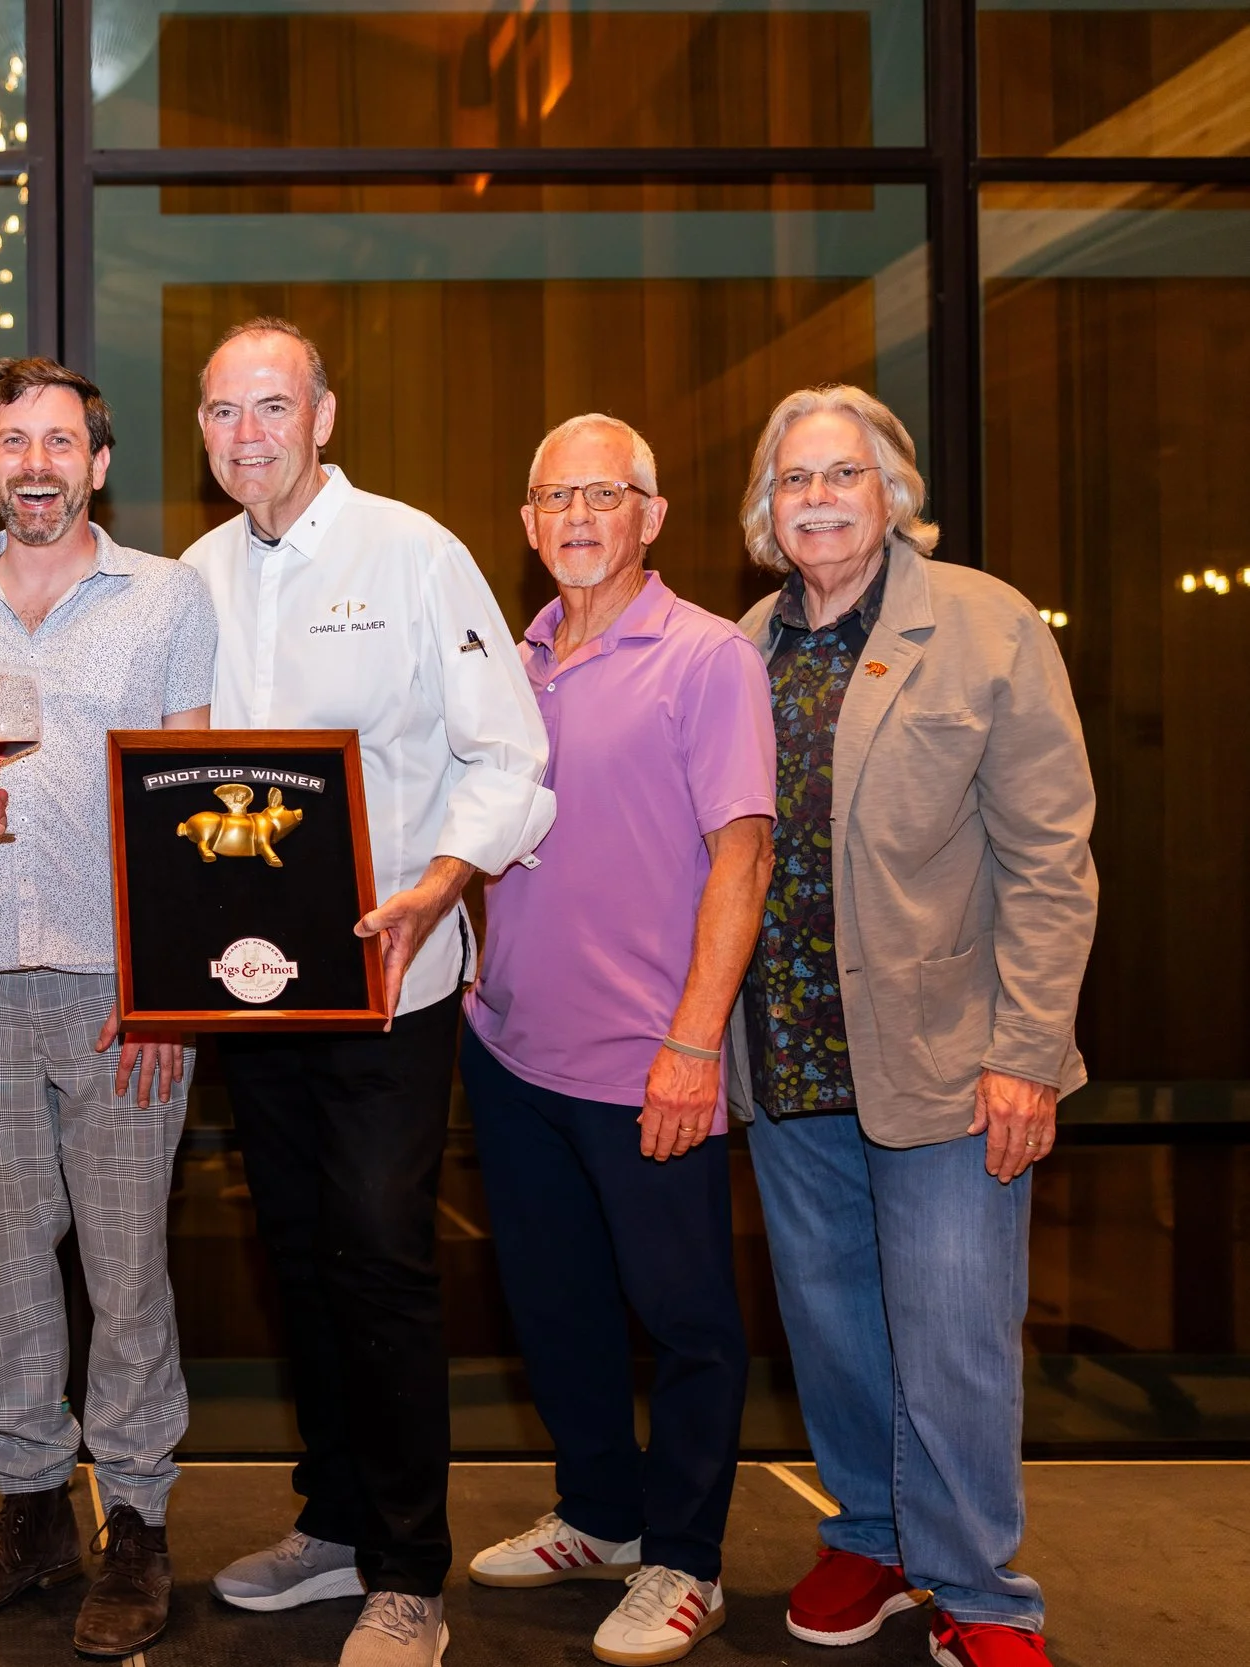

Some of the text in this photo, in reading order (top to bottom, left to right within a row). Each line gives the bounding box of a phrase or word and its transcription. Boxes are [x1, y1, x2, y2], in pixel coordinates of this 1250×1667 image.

[310, 620, 386, 634] CHARLIE PALMER
[147, 769, 321, 790] PINOT CUP WINNER
[224, 940, 283, 963] CHARLIE PALMER'S
[215, 961, 295, 978] Pigs & Pinot
[264, 980, 284, 999] ANNUAL
